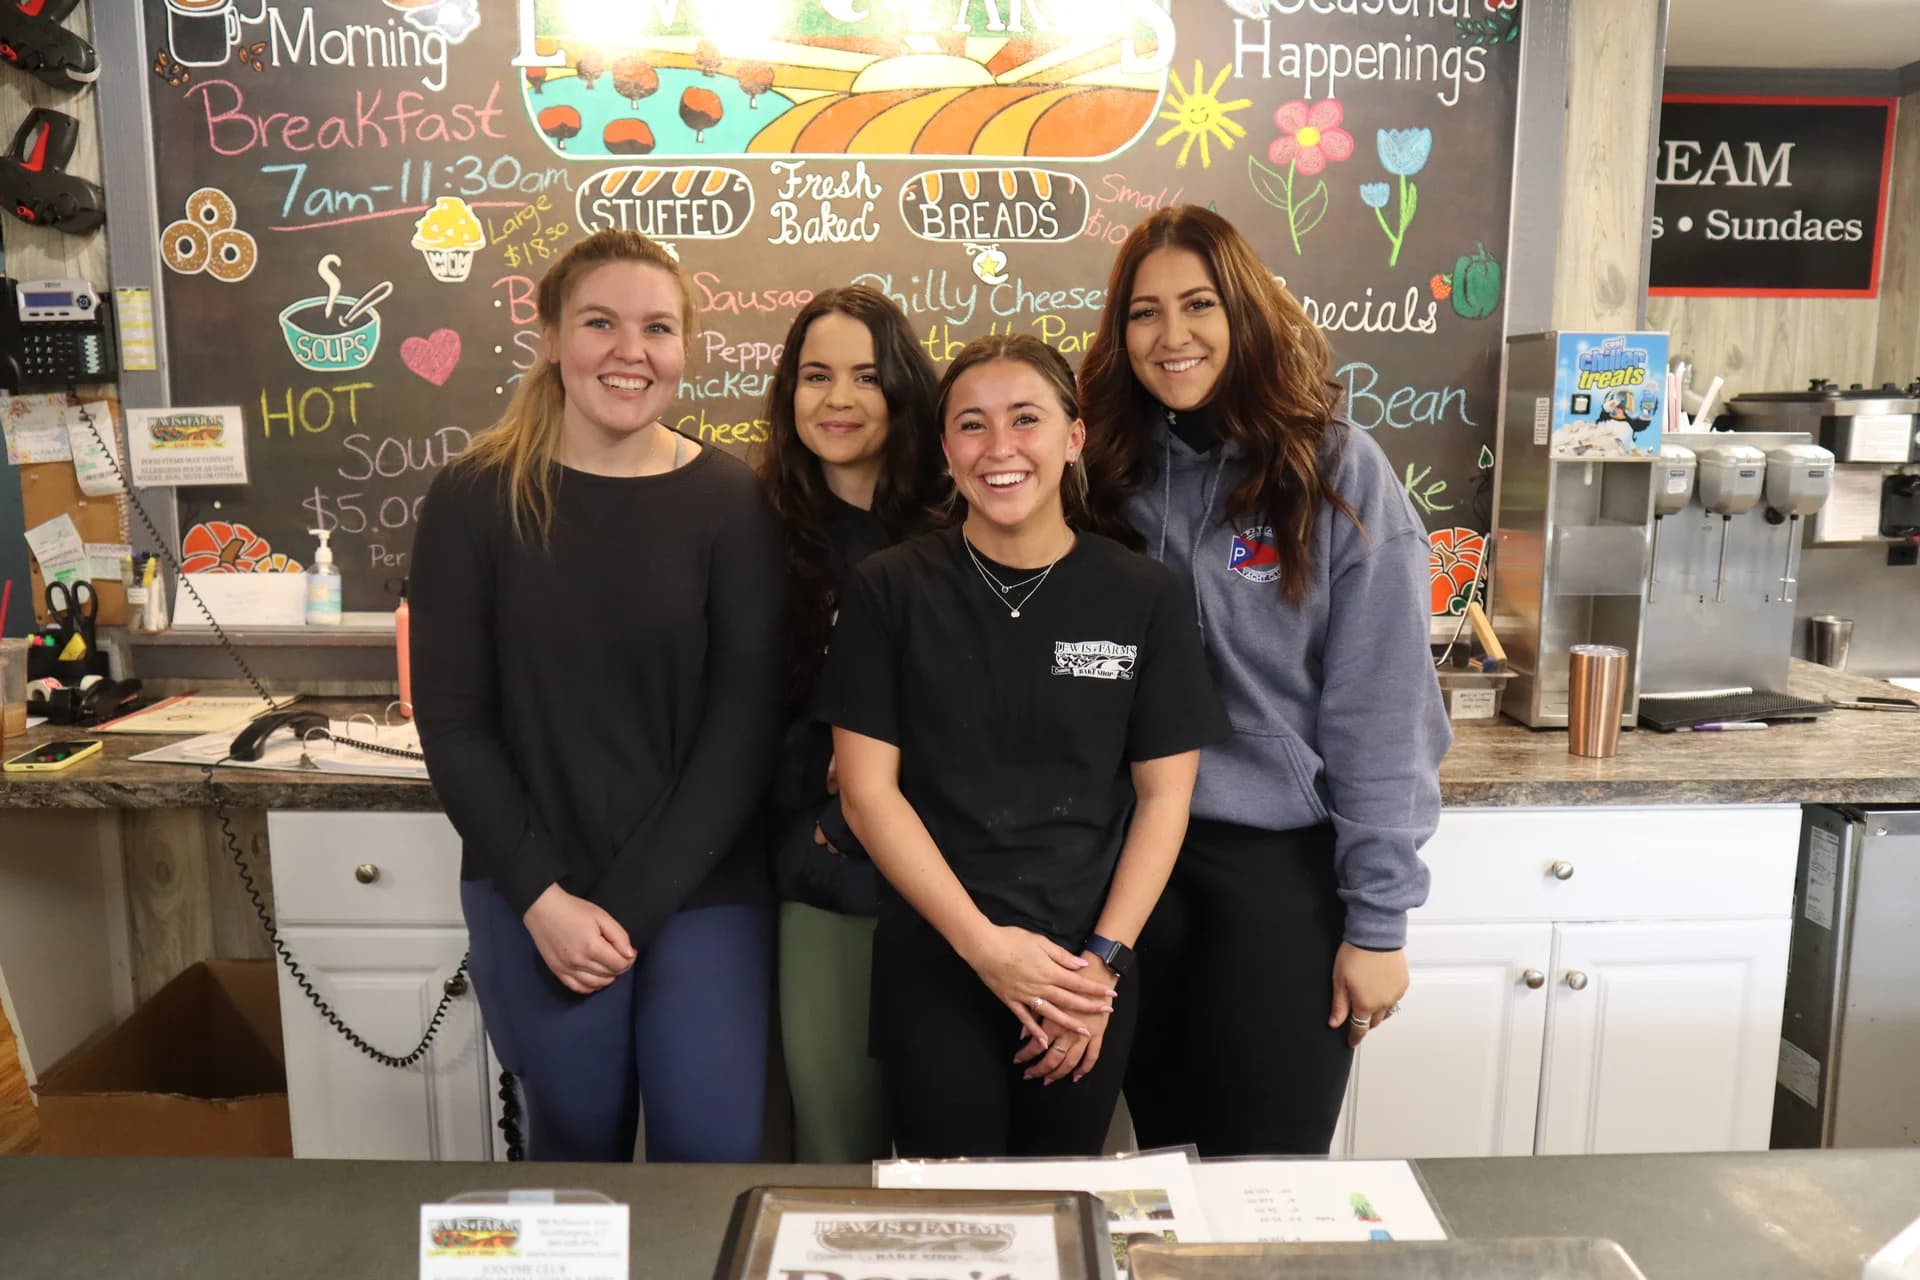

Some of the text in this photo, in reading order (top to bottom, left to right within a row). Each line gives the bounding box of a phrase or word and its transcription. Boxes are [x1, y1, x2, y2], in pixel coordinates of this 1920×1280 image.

[267, 7, 448, 91] Morning
[1233, 18, 1487, 106] Happenings
[184, 79, 508, 155] Breakfast
[770, 160, 882, 199] Fresh
[1655, 140, 1795, 187] EAM
[1095, 173, 1184, 210] Small
[487, 194, 552, 245] Large
[592, 198, 733, 236] STUFFED
[768, 201, 880, 245] Baked
[919, 201, 1058, 238] BREADS
[1705, 209, 1863, 241] Sundaes
[1303, 286, 1438, 334] pecials
[297, 334, 369, 363] SOUPS
[1335, 362, 1479, 431] Bean
[1578, 366, 1645, 389] treats
[260, 382, 374, 438] HOT
[338, 426, 471, 480] SOUP
[368, 544, 406, 568] Per
[1234, 547, 1246, 561] P
[1100, 643, 1137, 658] FARMS
[922, 1221, 1015, 1238] FARMS
